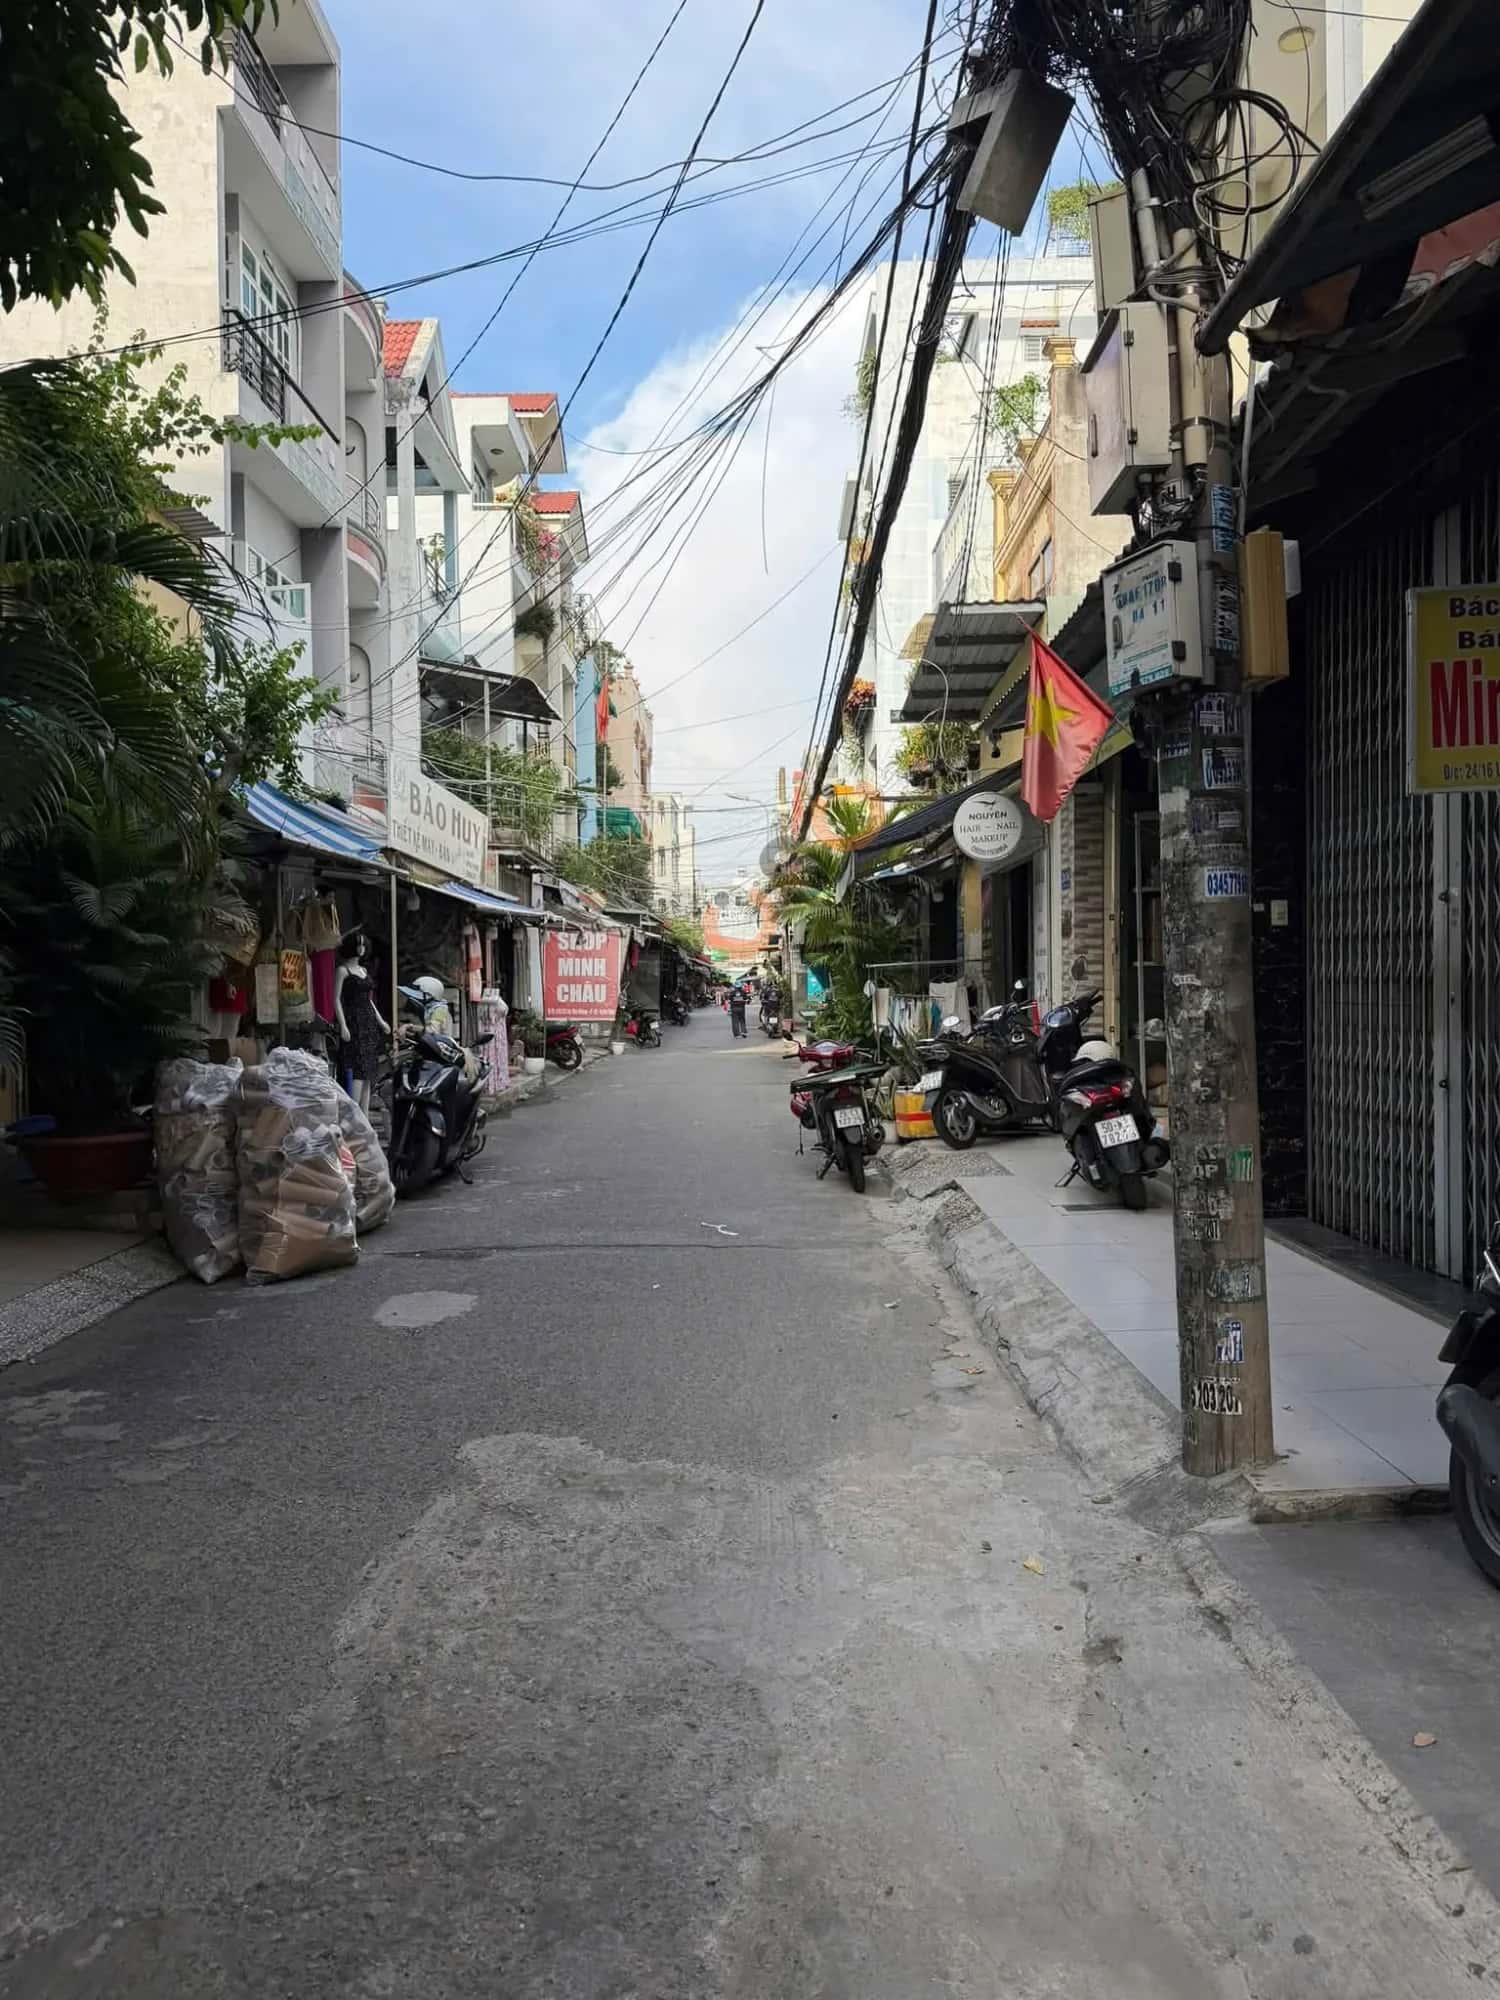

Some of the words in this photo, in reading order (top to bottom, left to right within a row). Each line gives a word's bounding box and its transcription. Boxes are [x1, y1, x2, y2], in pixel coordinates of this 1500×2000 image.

[1458, 629, 1500, 650] Bá
[410, 781, 447, 831] BẢO
[451, 807, 482, 849] HUY
[996, 821, 1018, 830] NAIL
[970, 833, 1008, 843] MAKEUP
[558, 958, 607, 977] MINH
[557, 980, 607, 1002] CHÂU
